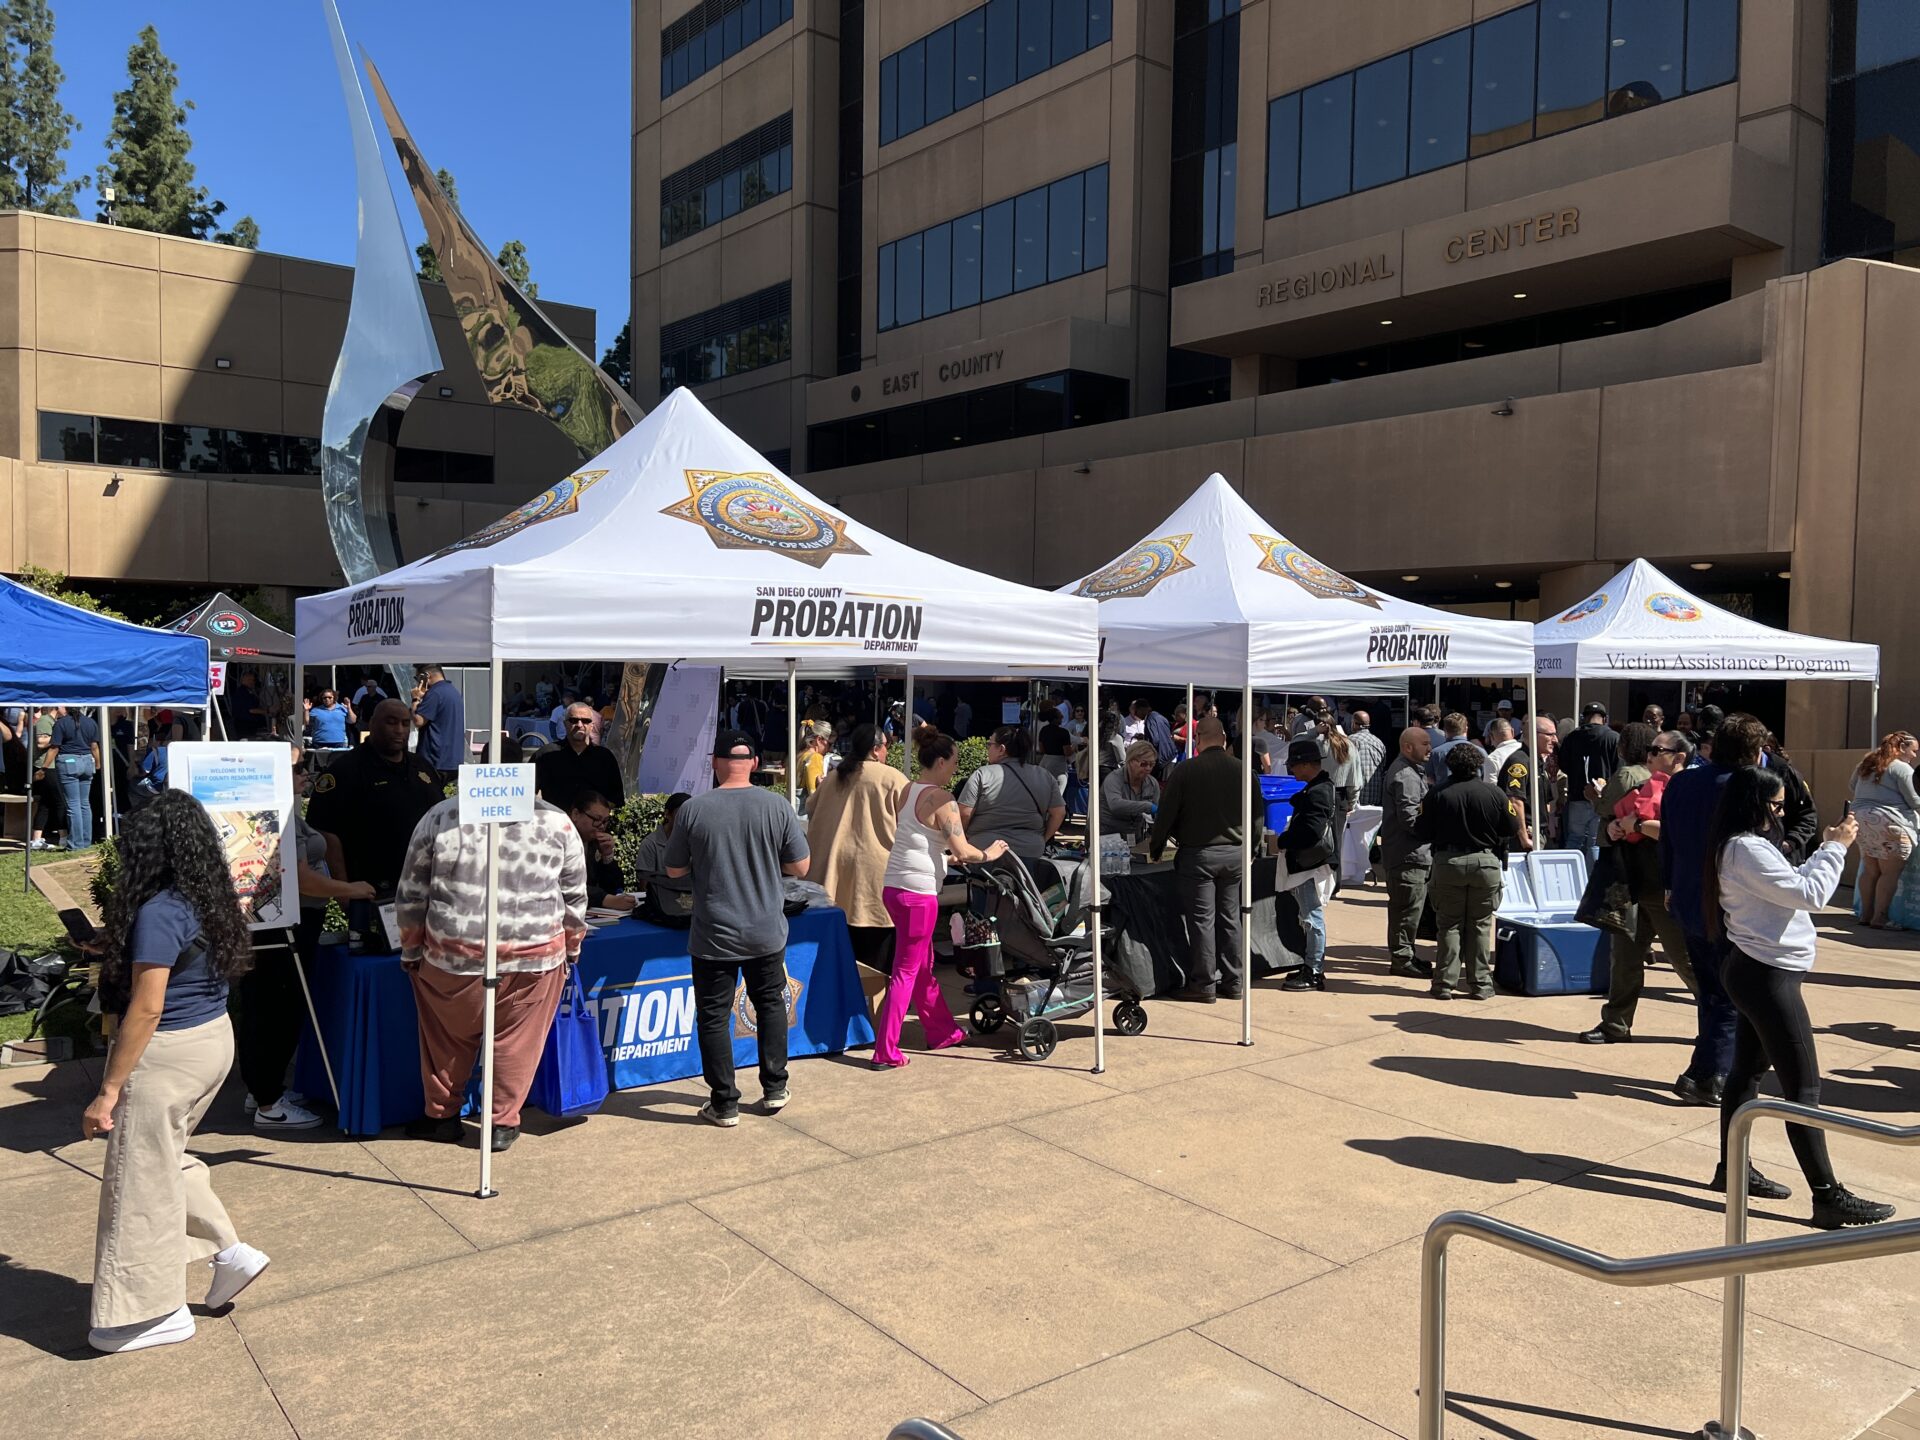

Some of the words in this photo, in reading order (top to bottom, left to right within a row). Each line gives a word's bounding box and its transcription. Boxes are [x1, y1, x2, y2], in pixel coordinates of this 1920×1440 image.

[1257, 253, 1395, 308] REGIONAL
[1443, 207, 1581, 264] CENTER
[883, 370, 919, 396] EAST
[939, 350, 1004, 382] COUNTY
[717, 523, 778, 547] COUNTY
[756, 586, 775, 597] SAN
[778, 587, 805, 598] DIEGO
[808, 587, 843, 598] COUNTY
[219, 620, 237, 628] PR
[347, 596, 405, 639] PROBATION
[750, 598, 923, 641] PROBATION
[1370, 626, 1380, 634] SAN
[1381, 625, 1394, 634] DIEGO
[1394, 624, 1411, 633] COUNTY
[863, 640, 919, 652] DEPARTMENT
[1366, 633, 1450, 662] PROBATION
[1536, 656, 1562, 673] gram
[1606, 652, 1666, 670] Victim
[1672, 652, 1769, 671] Assistance
[1774, 654, 1851, 675] Program
[475, 767, 519, 778] PLEASE
[469, 786, 508, 798] CHECK
[511, 786, 524, 796] IN
[481, 806, 512, 817] HERE
[610, 1036, 692, 1063] DEPARTMENT
